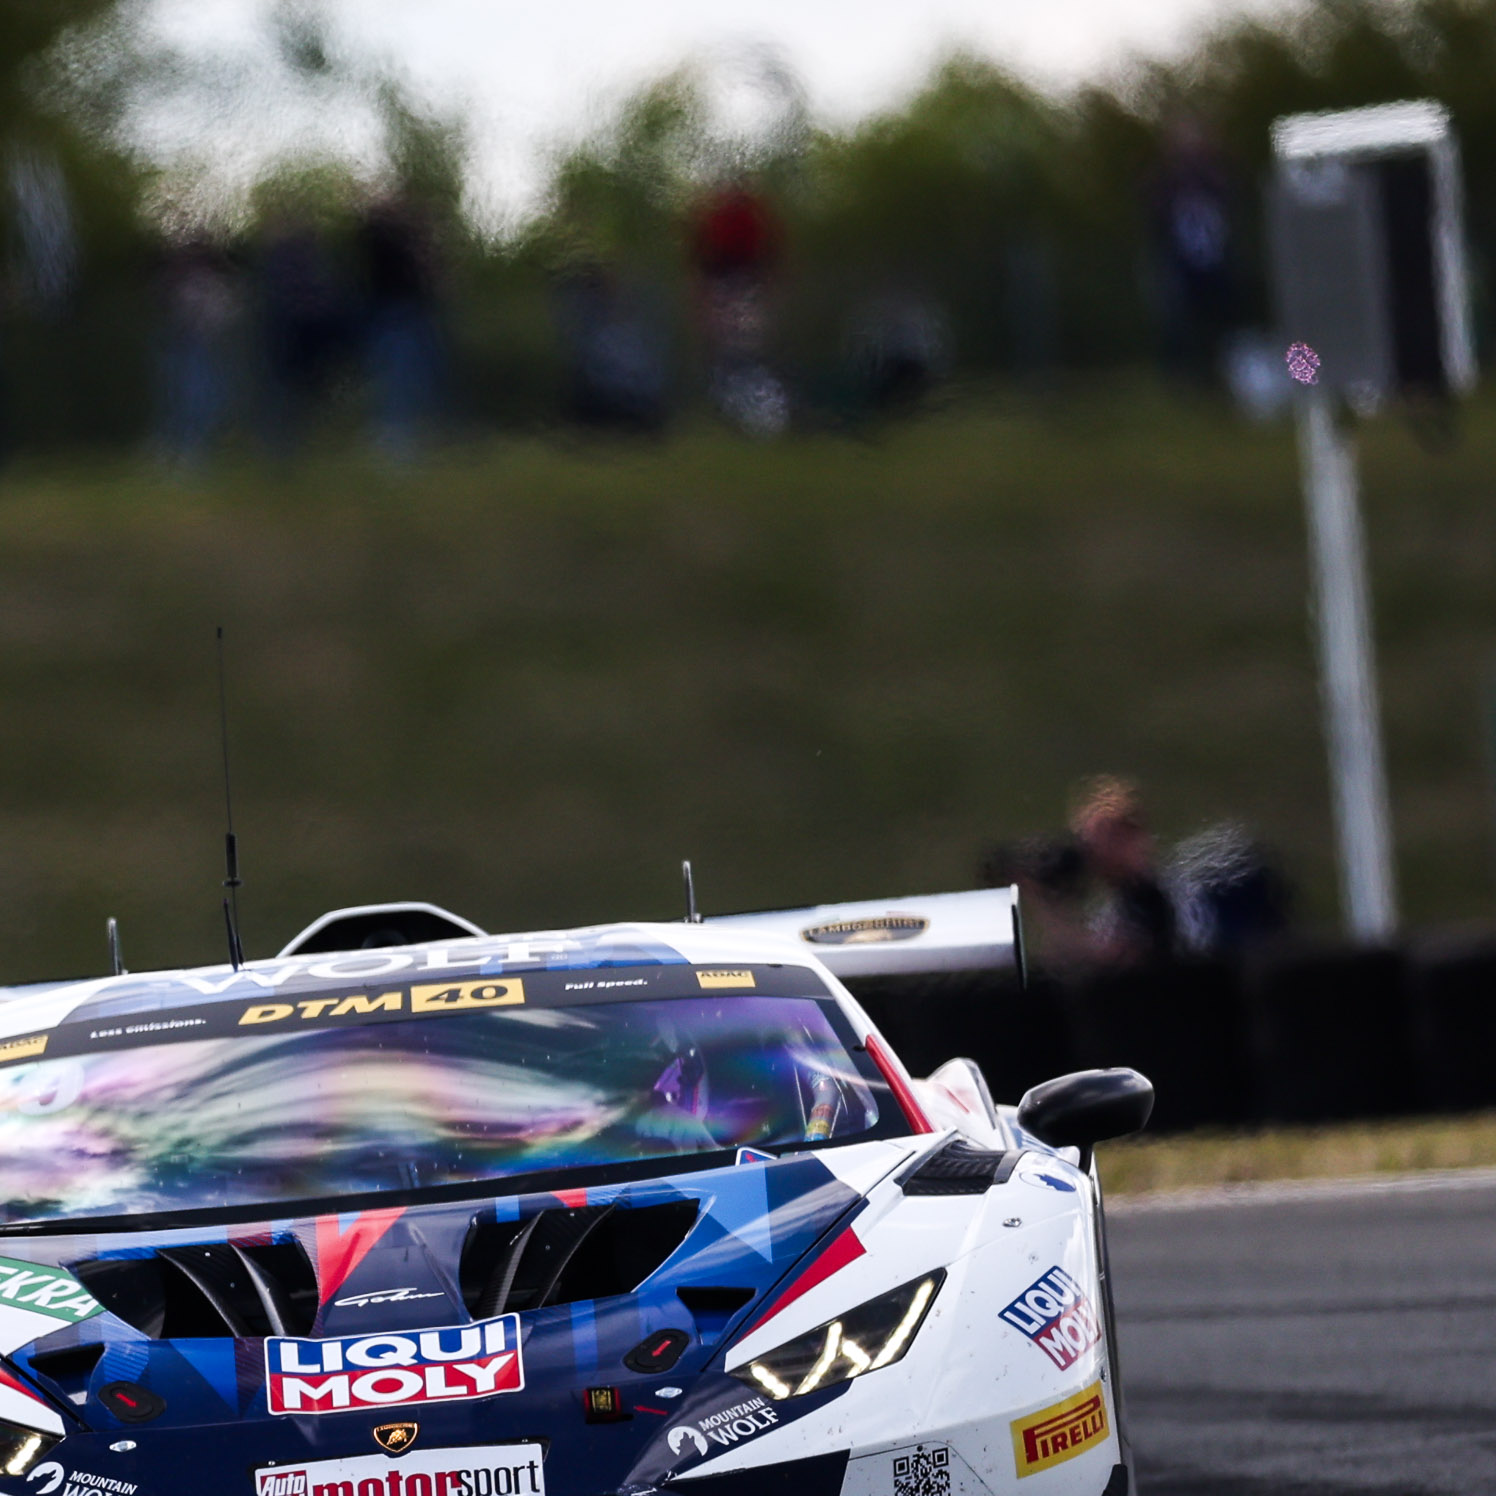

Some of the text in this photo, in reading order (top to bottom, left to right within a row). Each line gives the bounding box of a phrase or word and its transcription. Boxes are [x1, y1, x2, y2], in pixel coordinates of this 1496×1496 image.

[237, 984, 510, 1026] DTM 40
[1003, 1268, 1082, 1335] LIQUI
[279, 1320, 506, 1374] LIQUI
[1038, 1300, 1100, 1367] MOLY
[282, 1351, 516, 1411] MOLY
[698, 1397, 766, 1432] MOUNTAIN
[706, 1406, 779, 1446] WOLF
[1021, 1394, 1105, 1465] PIRELLI
[69, 1470, 139, 1496] MOUNTAIN
